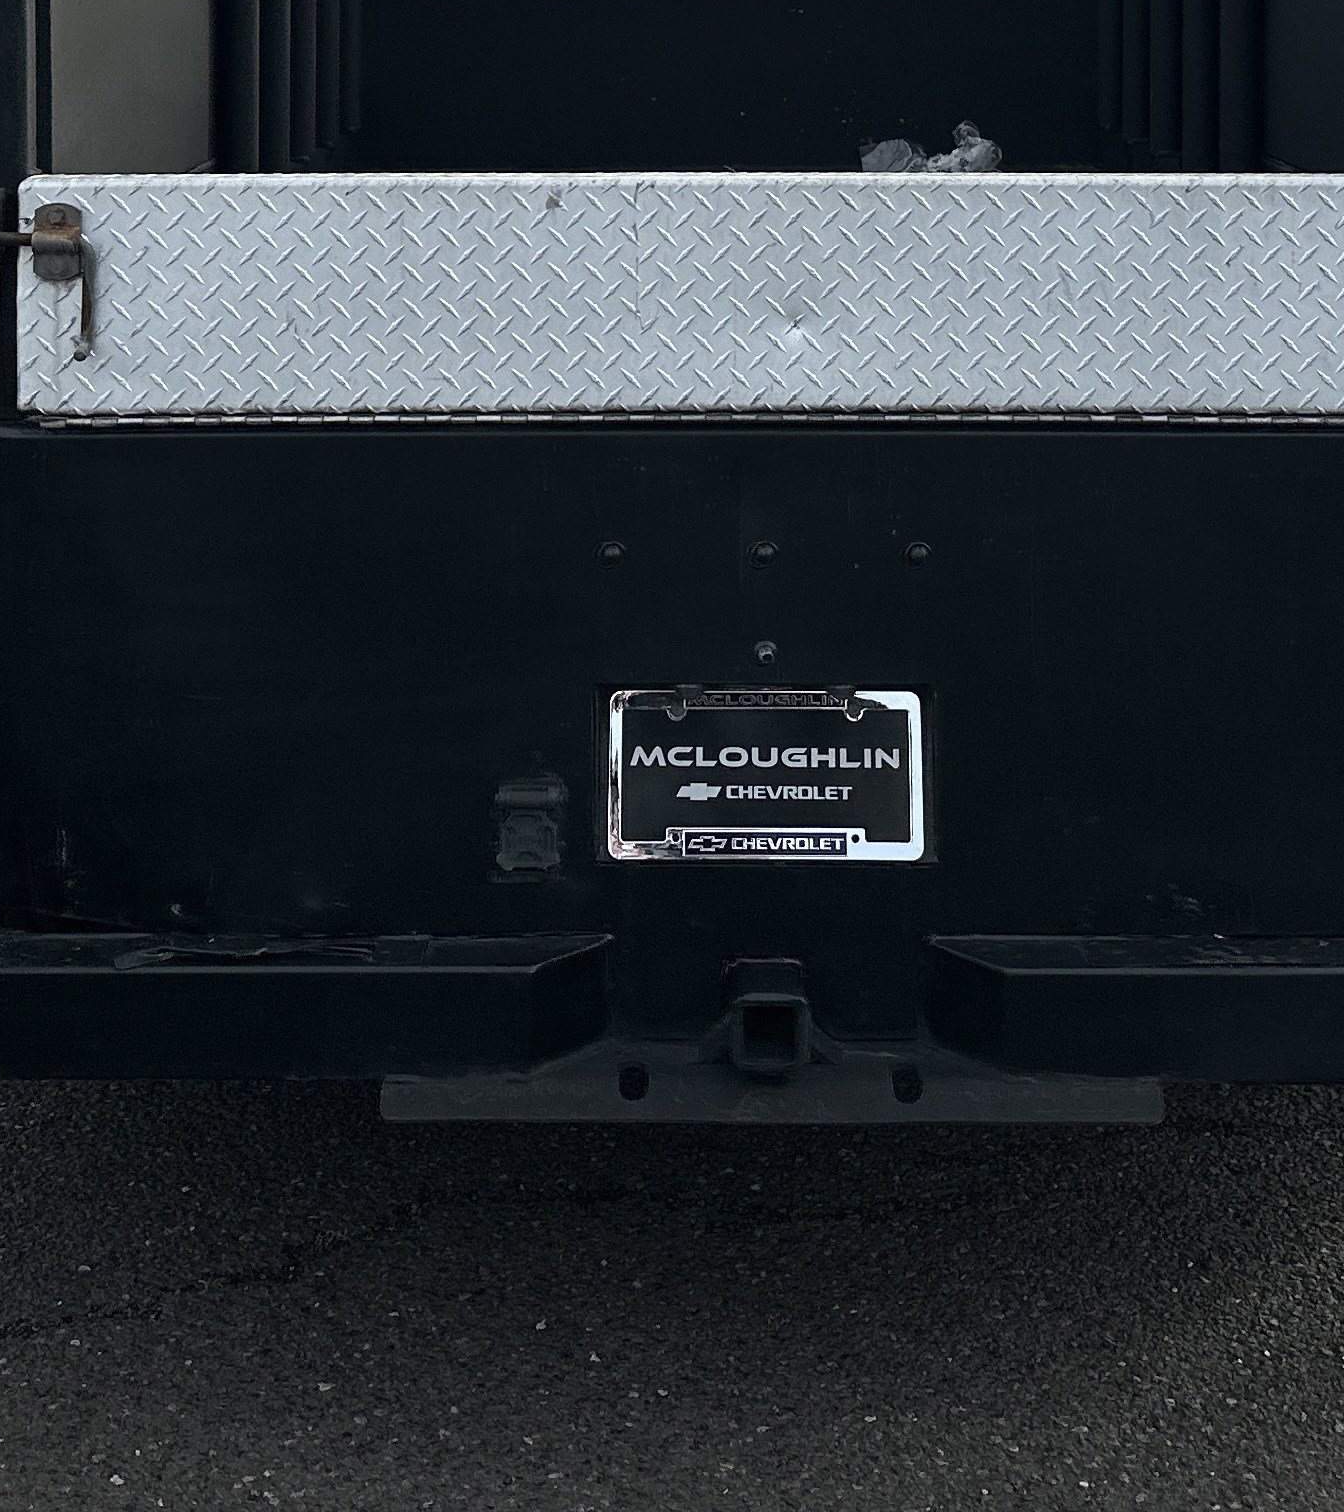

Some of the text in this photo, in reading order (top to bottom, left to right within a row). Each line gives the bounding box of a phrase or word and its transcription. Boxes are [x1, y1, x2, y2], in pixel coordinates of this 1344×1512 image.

[688, 693, 844, 707] MCLOUGHLIN
[629, 745, 900, 769] MCLOUGHLIN
[725, 784, 853, 801] CHEVROLET
[731, 836, 845, 852] CHEVROLET
